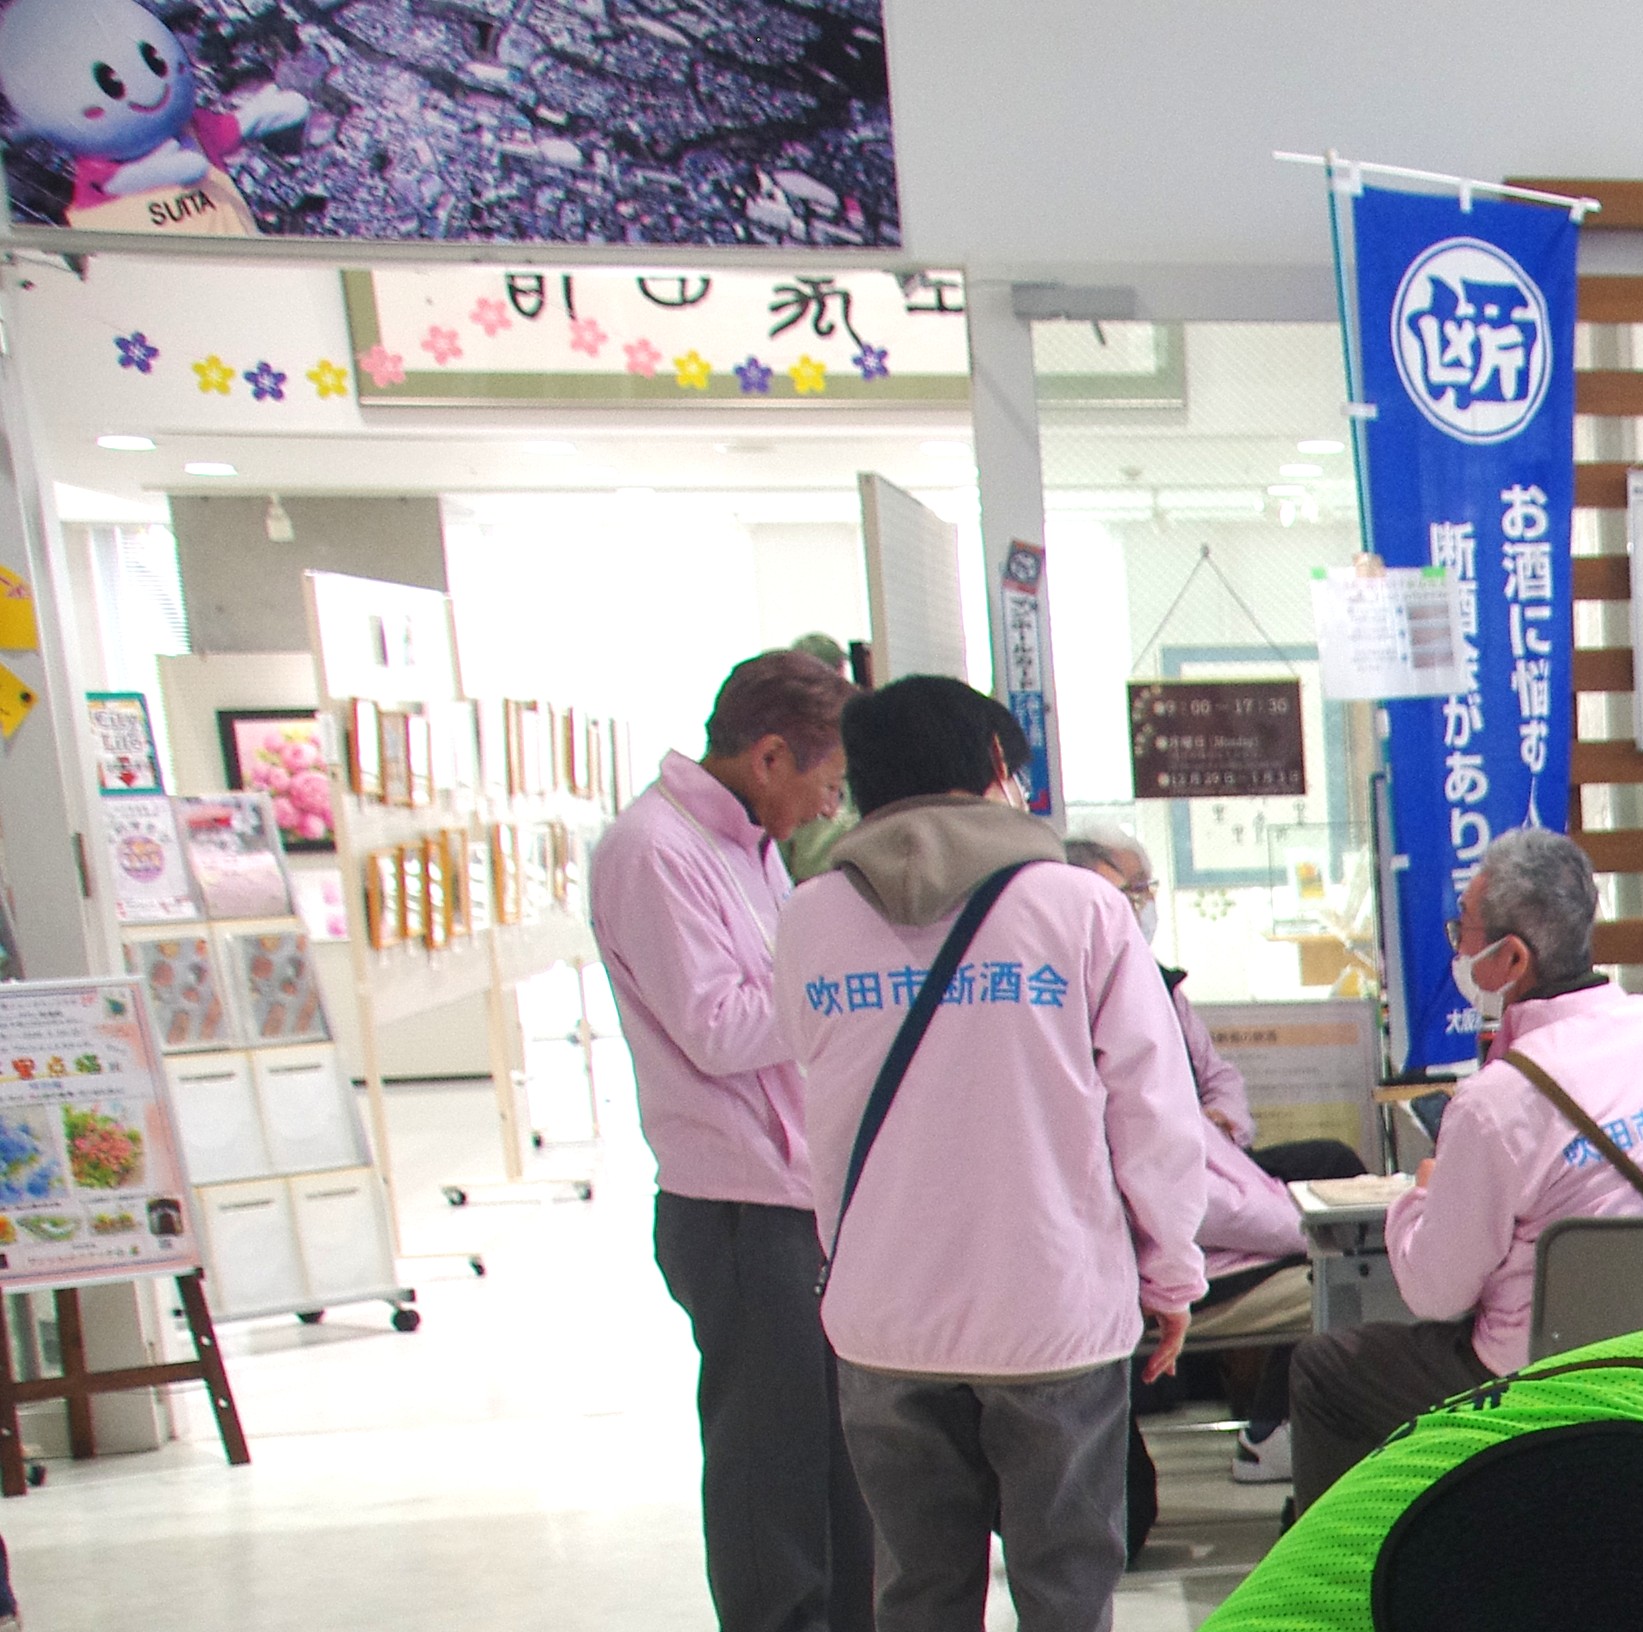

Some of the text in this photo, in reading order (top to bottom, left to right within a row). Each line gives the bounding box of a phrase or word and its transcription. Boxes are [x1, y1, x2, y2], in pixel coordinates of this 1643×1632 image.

[148, 190, 215, 227] SUITA
[806, 961, 1069, 1016] 吹田市断酒会
